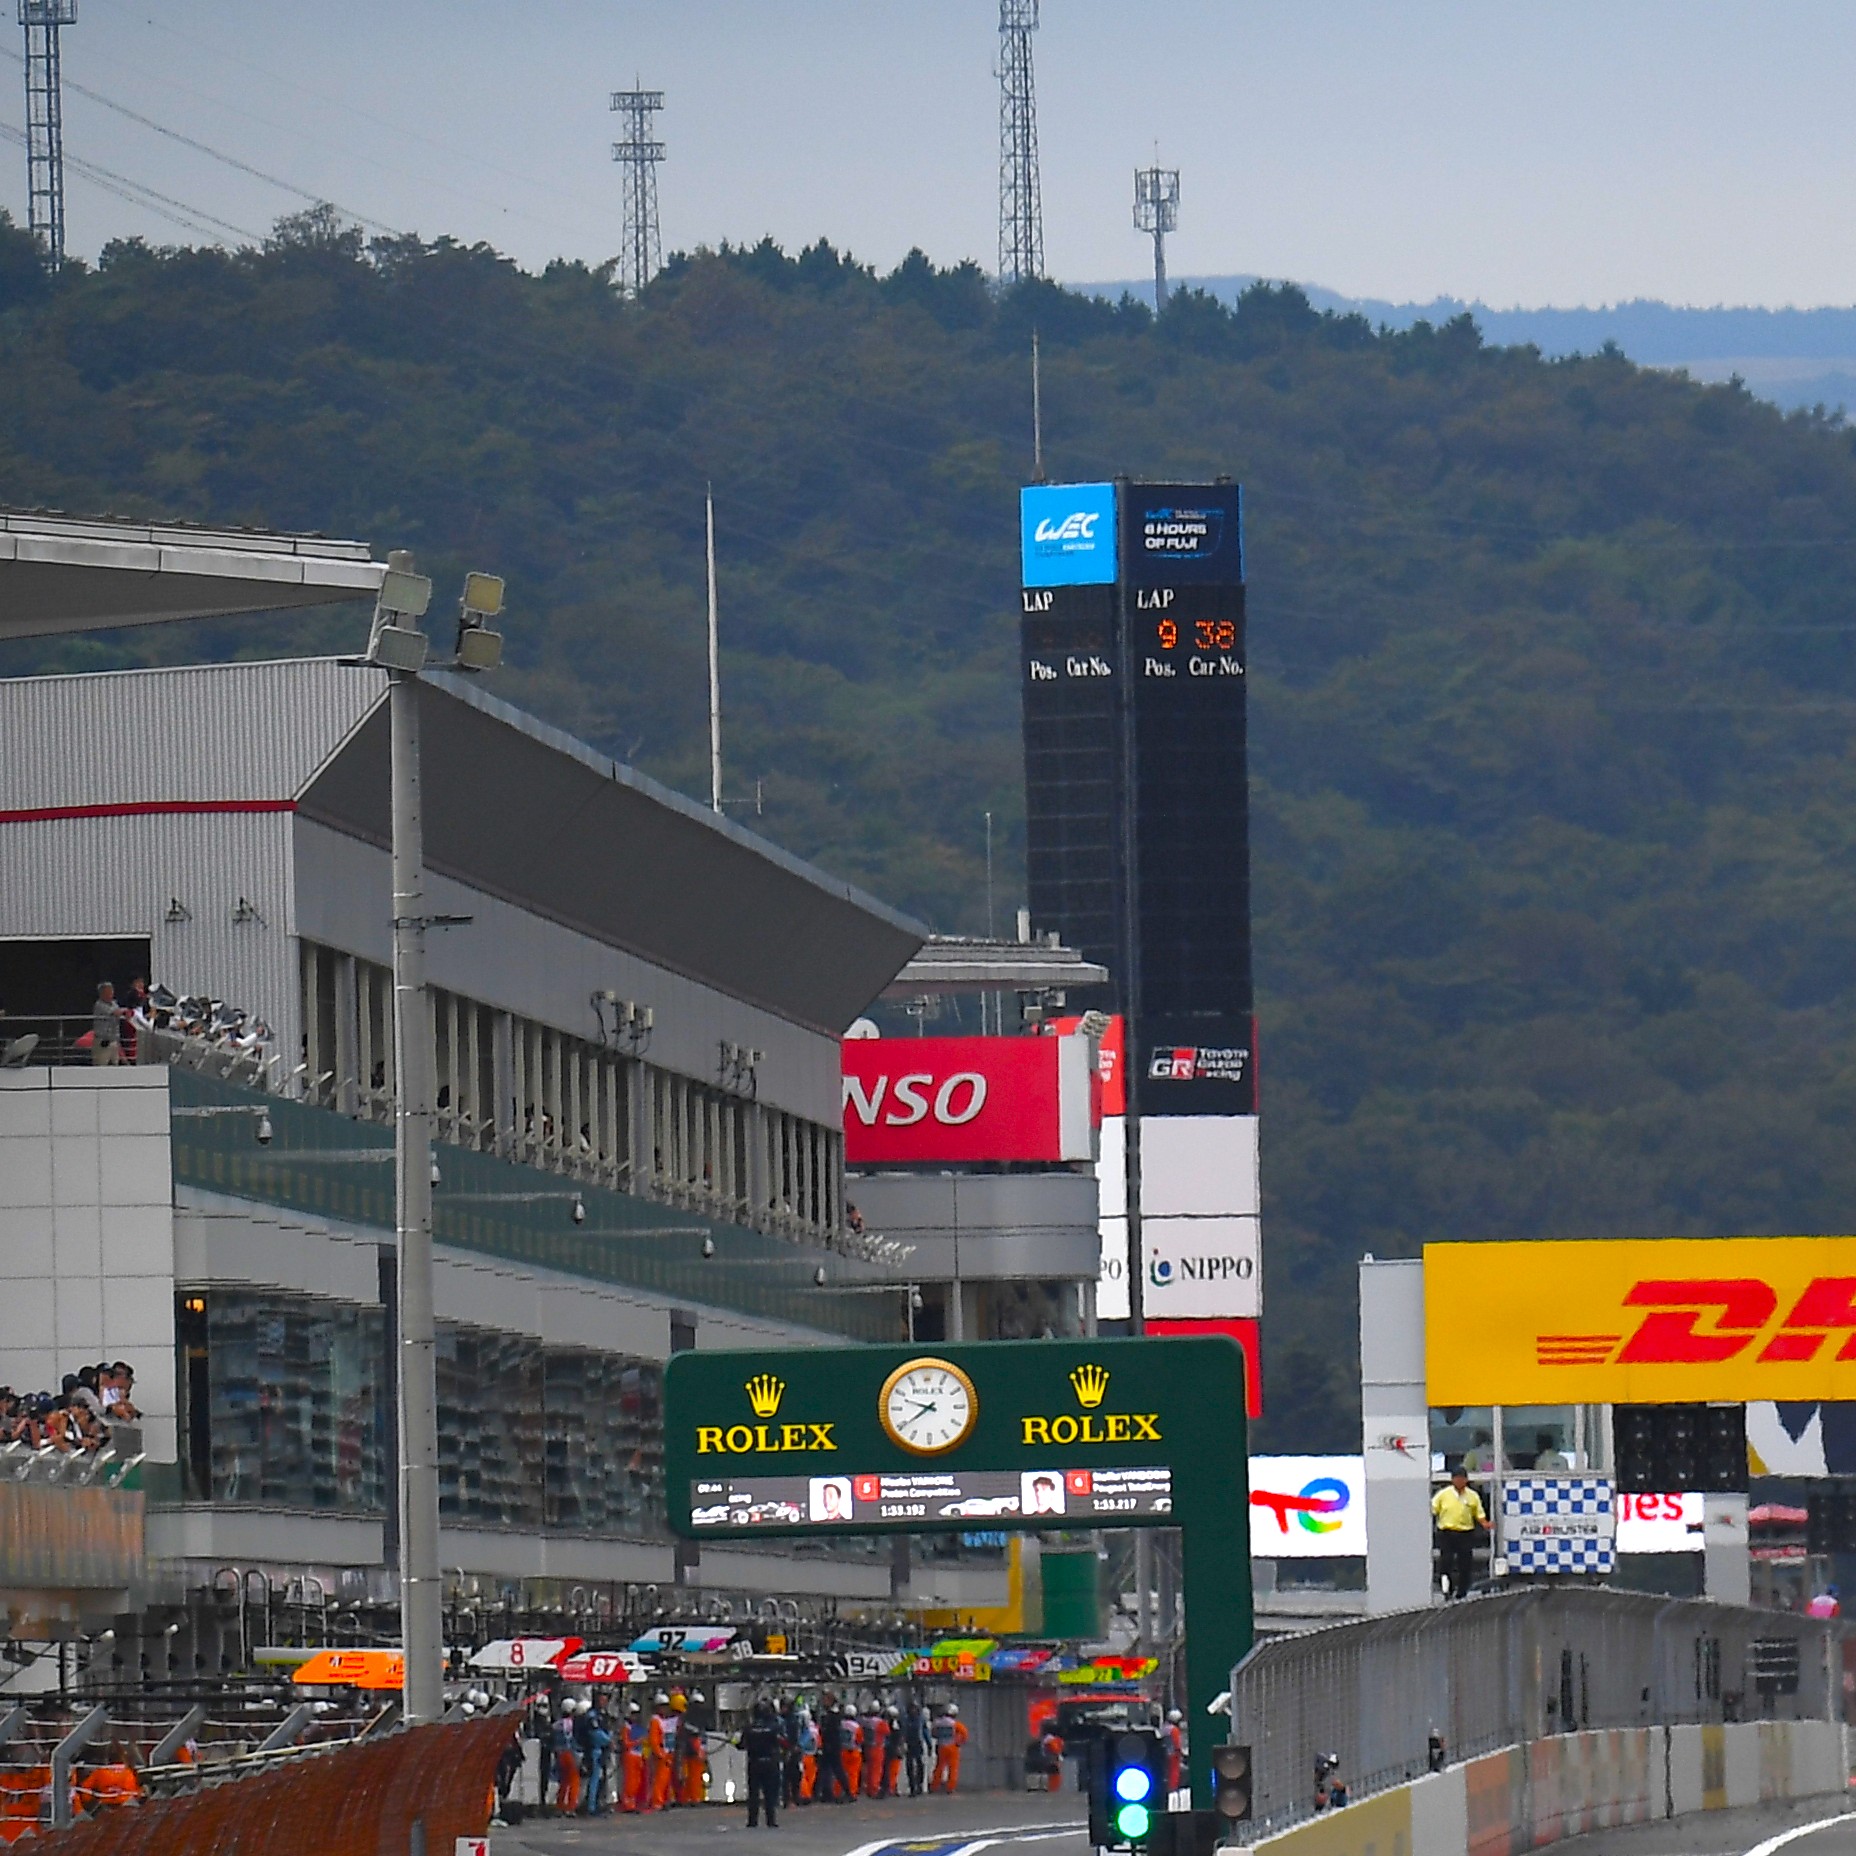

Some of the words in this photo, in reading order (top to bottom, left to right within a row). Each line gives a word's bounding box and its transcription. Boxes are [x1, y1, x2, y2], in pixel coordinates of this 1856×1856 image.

[1034, 511, 1100, 543] WEC
[1023, 592, 1053, 612] LAP
[1136, 588, 1175, 610] LAP
[1157, 619, 1178, 649] 9
[1195, 619, 1236, 649] 38
[1030, 661, 1057, 681] Pos.
[1066, 657, 1088, 678] Car
[1144, 658, 1176, 677] Pos.
[1189, 656, 1216, 677] Car
[1219, 656, 1244, 676] No.
[1180, 1256, 1253, 1281] NIPPO
[911, 1386, 945, 1395] ROLEX
[696, 1423, 838, 1454] ROLEX
[1021, 1413, 1162, 1445] ROLEX
[658, 1630, 686, 1652] 92
[511, 1642, 524, 1666] 8
[850, 1656, 880, 1674] 94
[591, 1658, 618, 1677] 87
